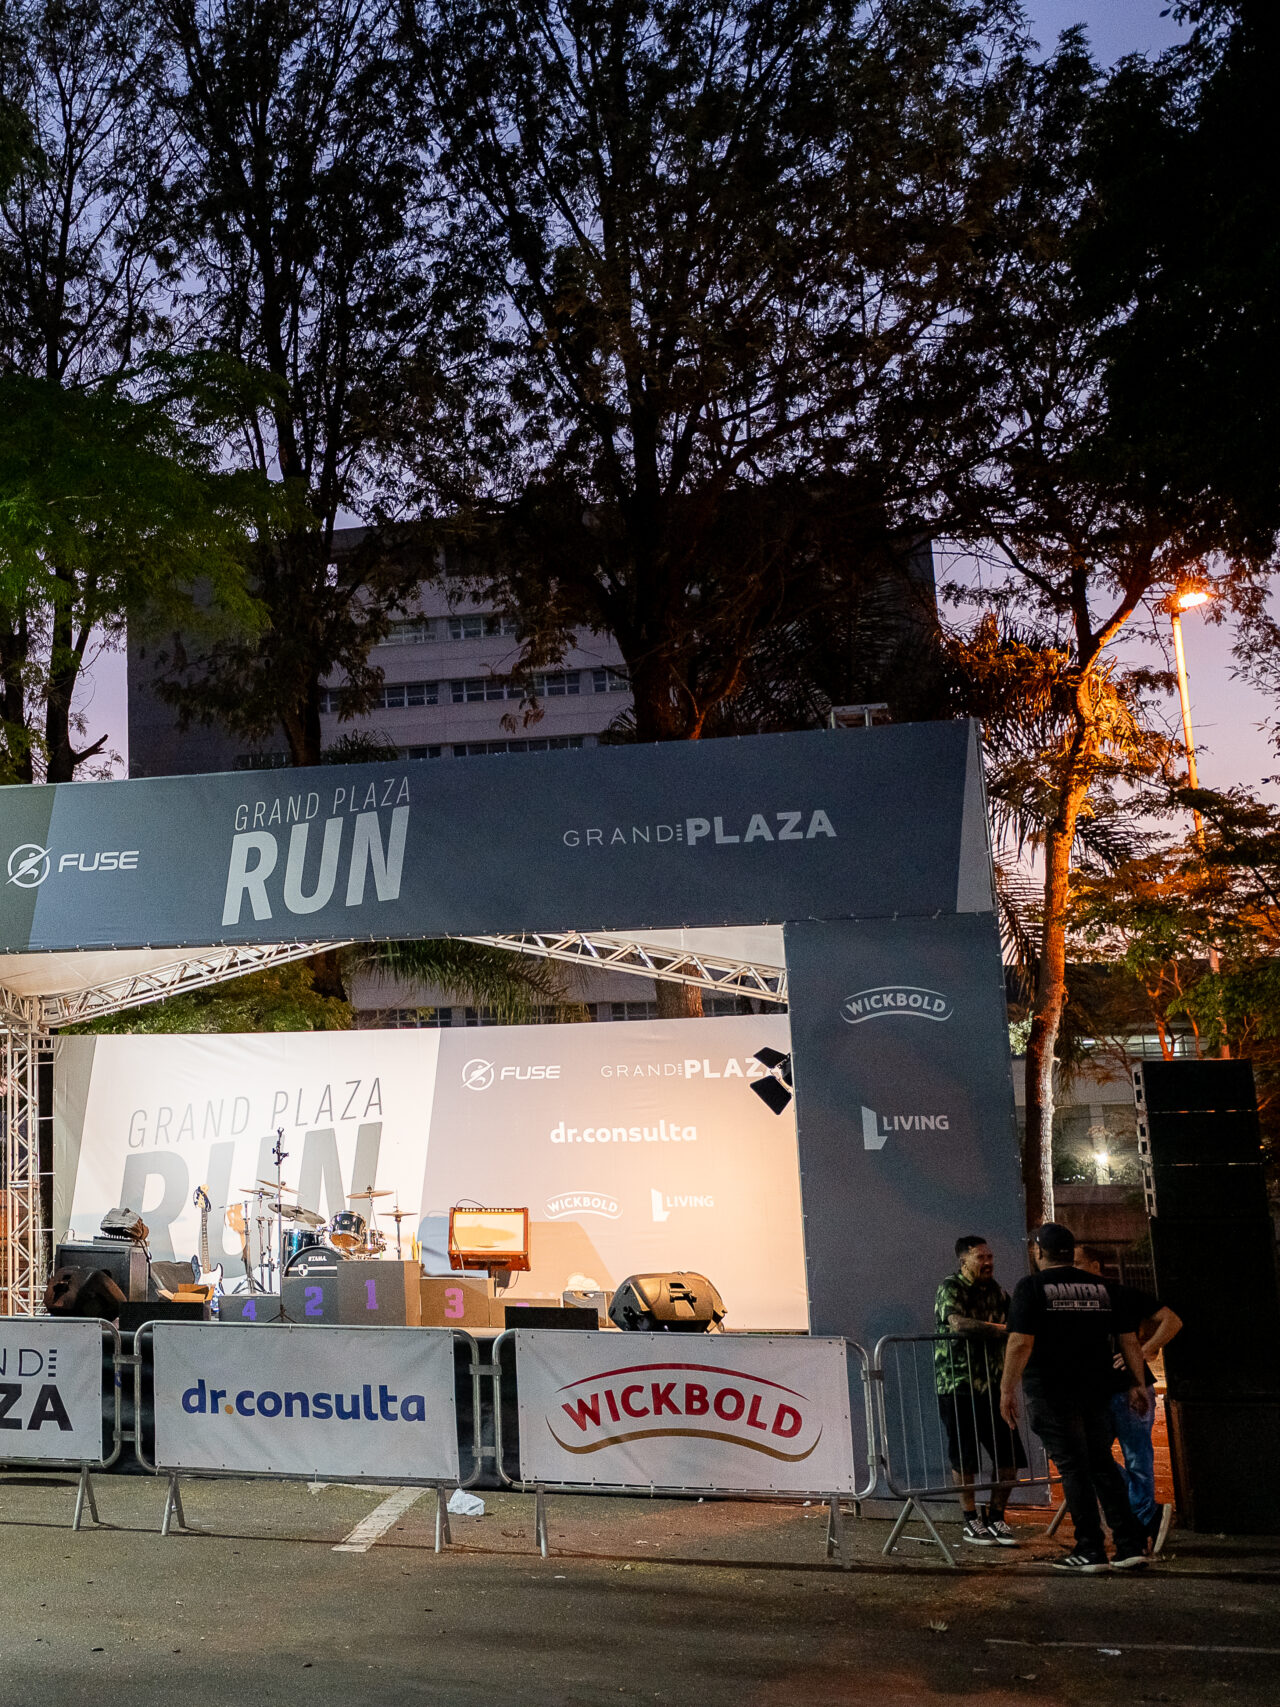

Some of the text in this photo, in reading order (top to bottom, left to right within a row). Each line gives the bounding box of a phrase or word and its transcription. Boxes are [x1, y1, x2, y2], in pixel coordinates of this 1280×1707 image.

[235, 776, 410, 831] GRAND PLAZA
[563, 810, 837, 847] GRAND PLAZA
[58, 850, 139, 873] FUSE
[221, 806, 409, 926] RUN
[845, 992, 946, 1016] WICKBOLD
[500, 1065, 561, 1080] FUSE
[601, 1064, 676, 1078] GRAND
[128, 1077, 383, 1148] GRAND PLAZA
[883, 1114, 949, 1131] LIVING
[550, 1120, 697, 1144] dr.consulta
[118, 1122, 383, 1279] RUN
[546, 1196, 618, 1214] WICKBOLD
[667, 1195, 714, 1208] LIVING
[304, 1286, 323, 1316] 2
[365, 1279, 379, 1310] 1
[444, 1287, 464, 1319] 3
[242, 1300, 257, 1321] 4
[181, 1378, 426, 1423] dr.consulta
[561, 1382, 803, 1439] WICKBOLD
